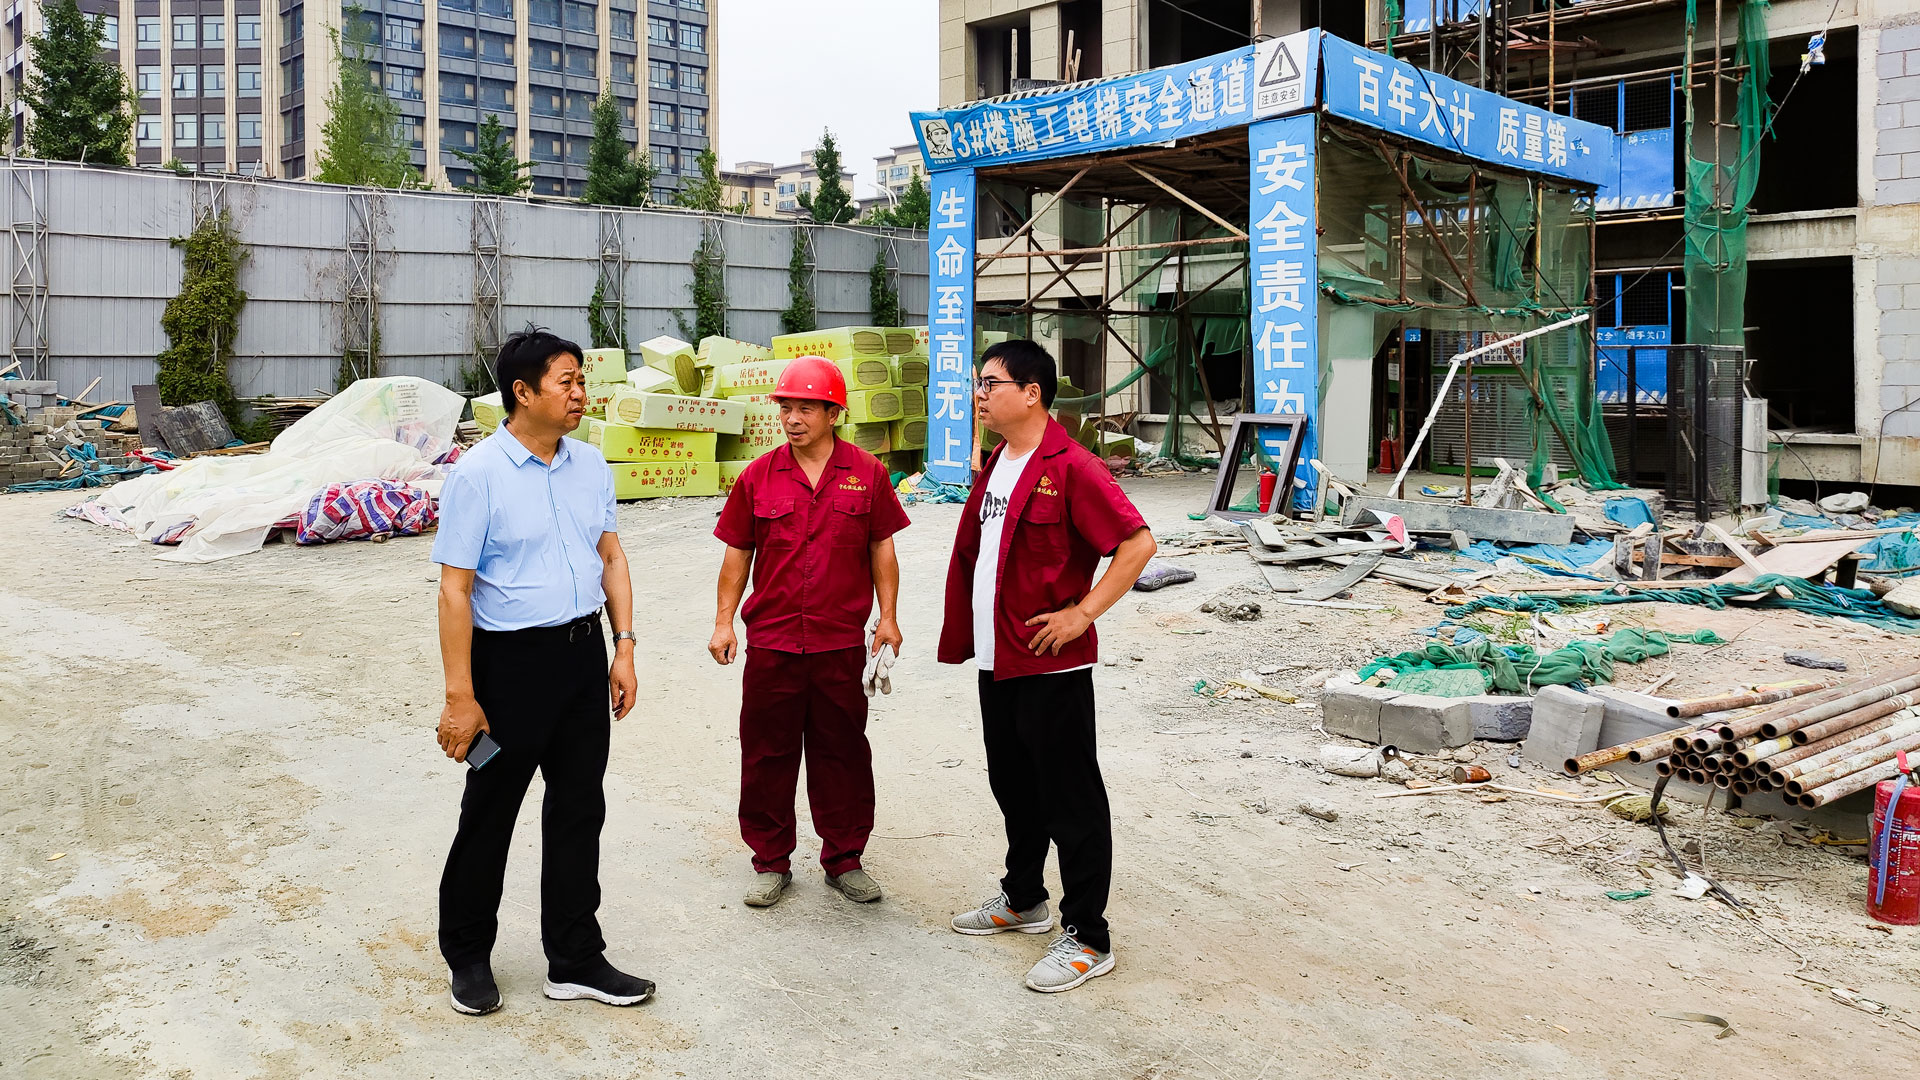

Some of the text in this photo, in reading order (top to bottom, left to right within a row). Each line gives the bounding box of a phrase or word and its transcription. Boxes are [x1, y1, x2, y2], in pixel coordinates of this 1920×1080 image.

[953, 56, 1248, 158] 3#楼施工电梯安全通道
[1261, 88, 1297, 105] 注意安全
[1352, 55, 1475, 147] 百年大计
[934, 187, 966, 468] 生命至高无上
